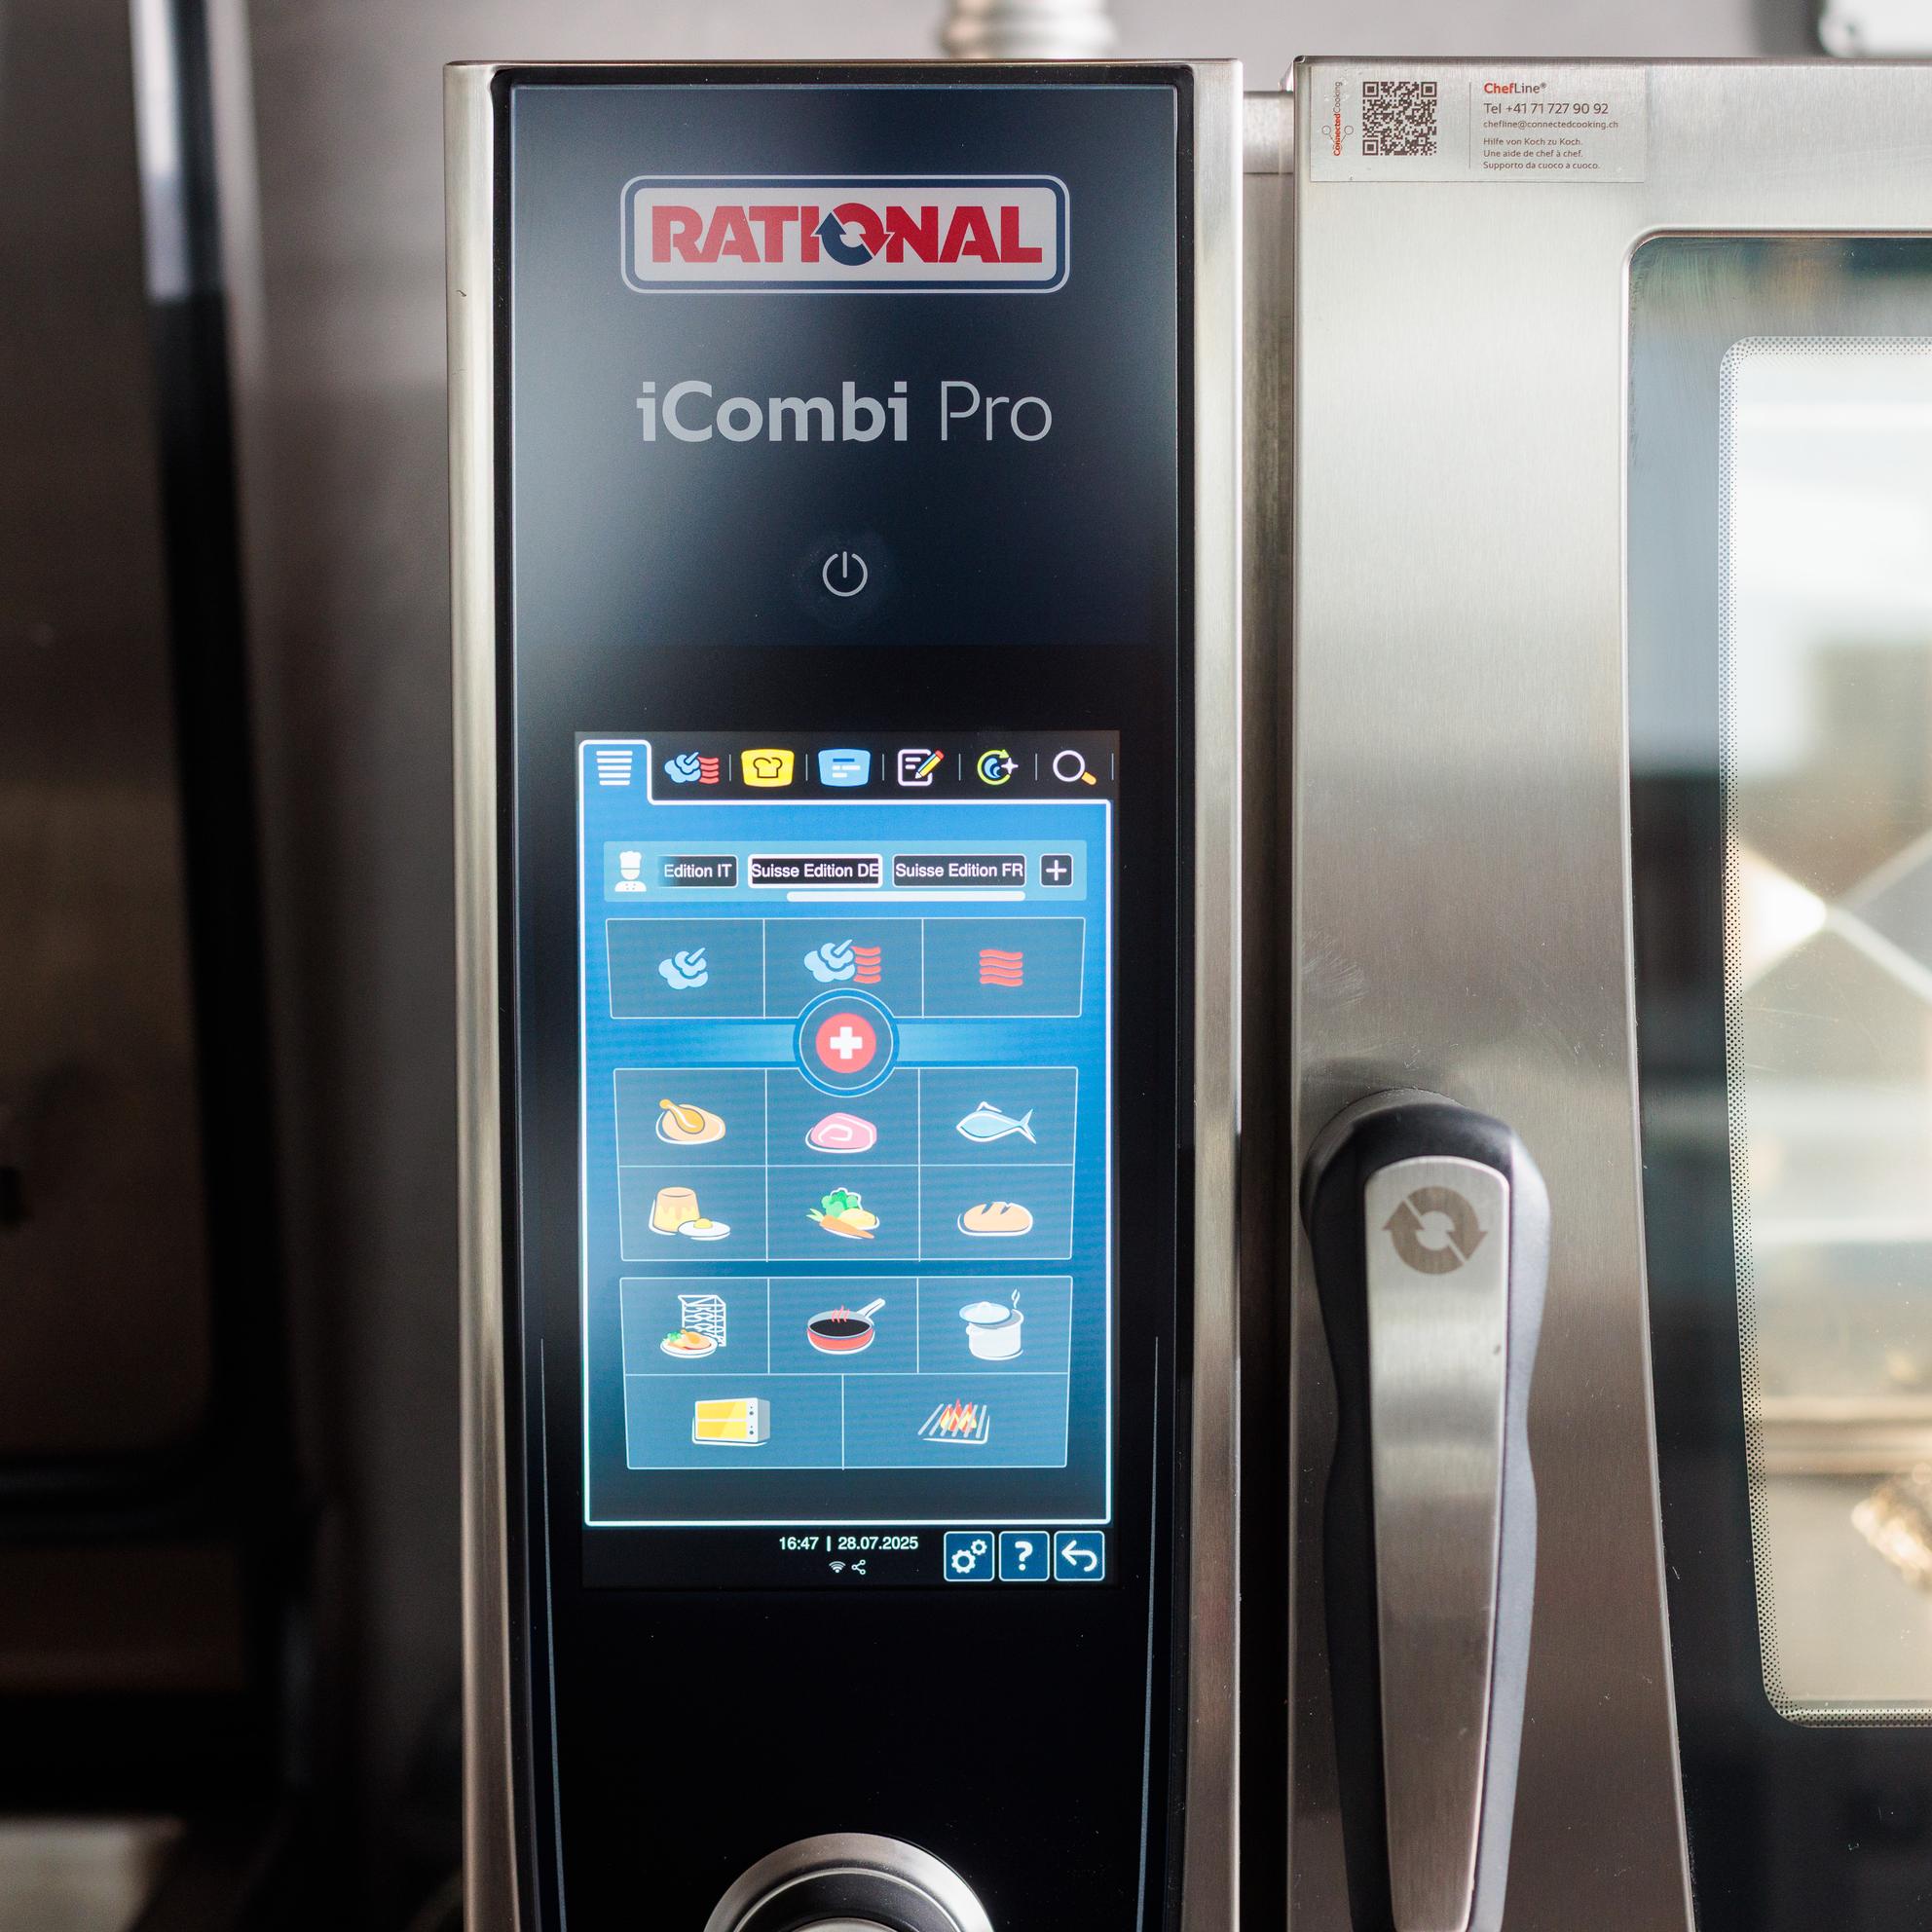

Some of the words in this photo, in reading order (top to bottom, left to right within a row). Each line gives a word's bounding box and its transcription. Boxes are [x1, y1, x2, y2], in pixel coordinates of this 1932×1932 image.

[1484, 103, 1502, 114] Tel
[1505, 103, 1527, 114] +41
[1531, 103, 1543, 114] 71
[1547, 103, 1570, 114] 727
[1573, 103, 1590, 114] 90
[1593, 103, 1609, 114] 92
[1483, 121, 1618, 130] chefline@connectedcooking.ch
[1483, 162, 1523, 170] Supporto
[651, 203, 1043, 266] RATIONAL
[636, 381, 909, 442] iCombi
[941, 381, 1053, 442] Pro
[664, 863, 713, 878] Edition
[718, 864, 732, 878] IT
[752, 863, 799, 878] Suisse
[804, 863, 853, 878] Edition
[858, 863, 879, 878] DE
[895, 863, 945, 877] Suisse
[948, 863, 998, 877] Edition
[1002, 863, 1023, 877] FR
[779, 1536, 819, 1550] 16:47
[837, 1536, 919, 1550] 28.07.2025
